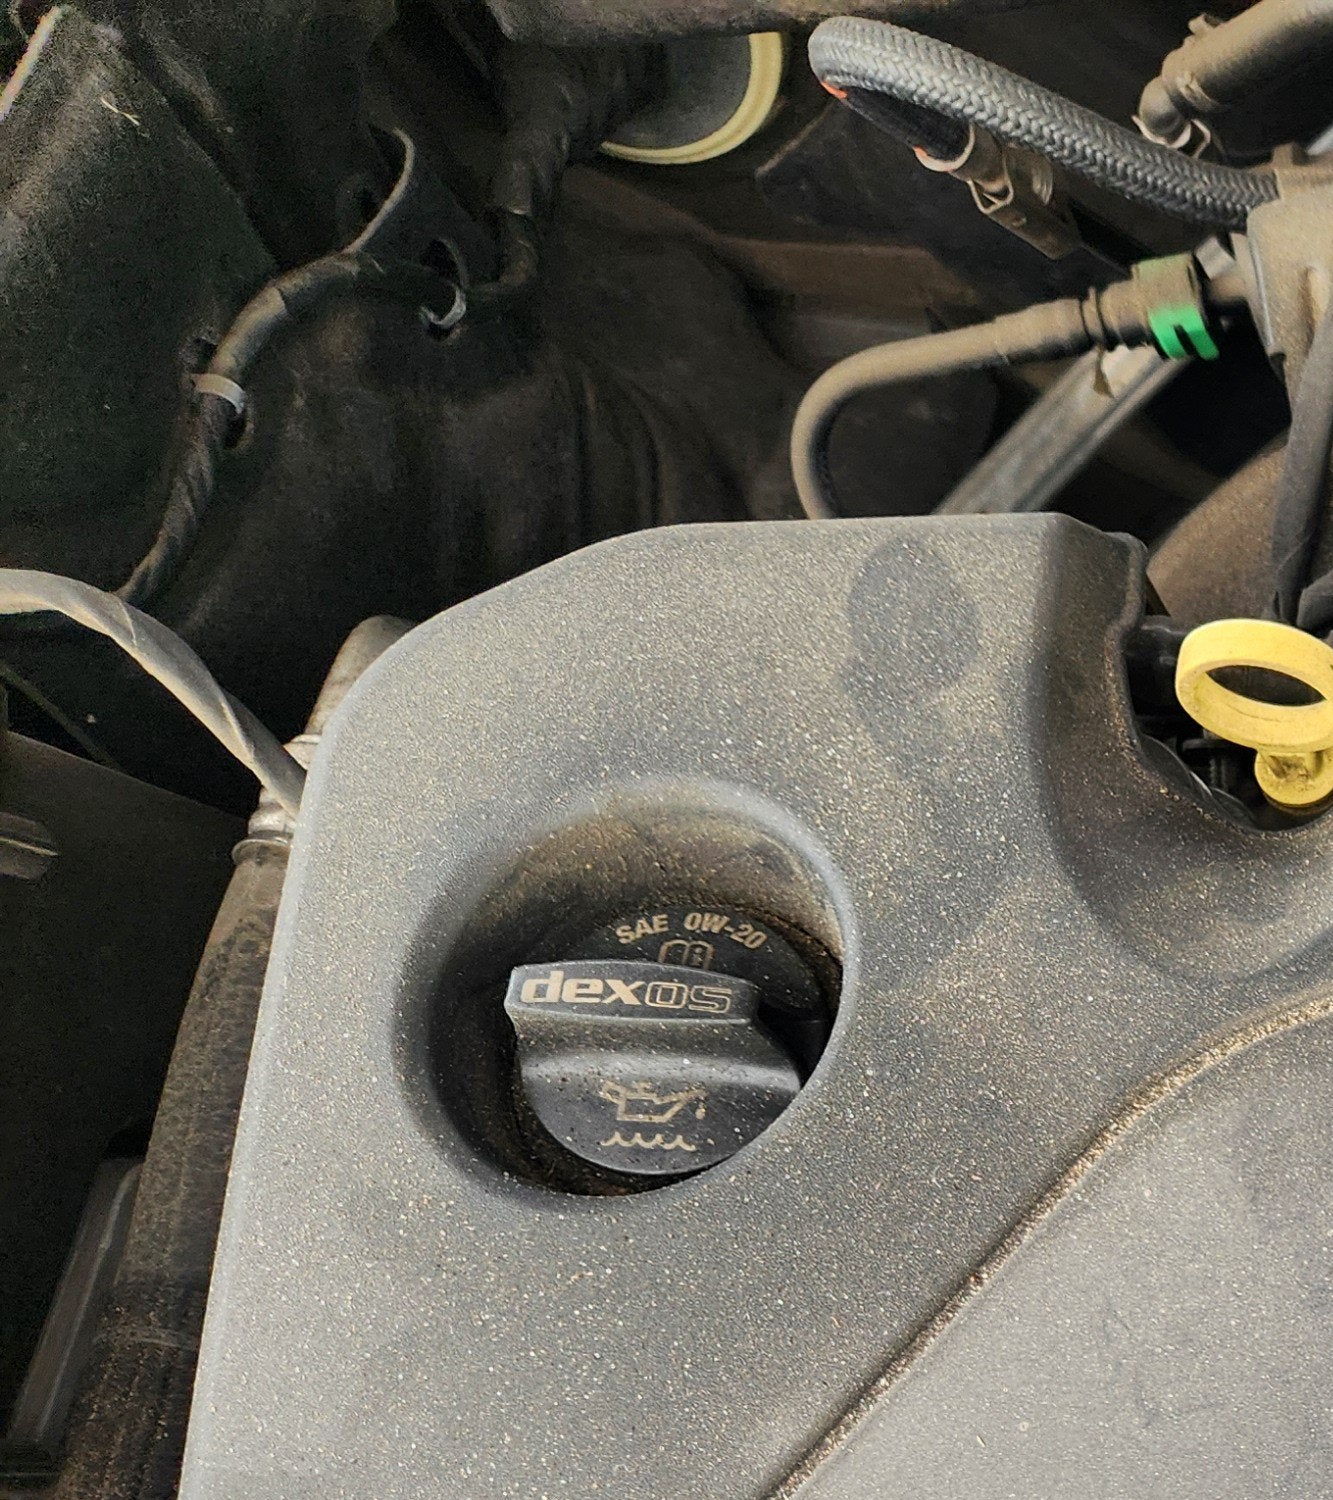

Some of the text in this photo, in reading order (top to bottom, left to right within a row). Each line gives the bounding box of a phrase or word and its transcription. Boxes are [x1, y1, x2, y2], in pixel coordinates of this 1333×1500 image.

[616, 912, 768, 950] SAE 0W-20
[519, 970, 732, 1014] dexos
